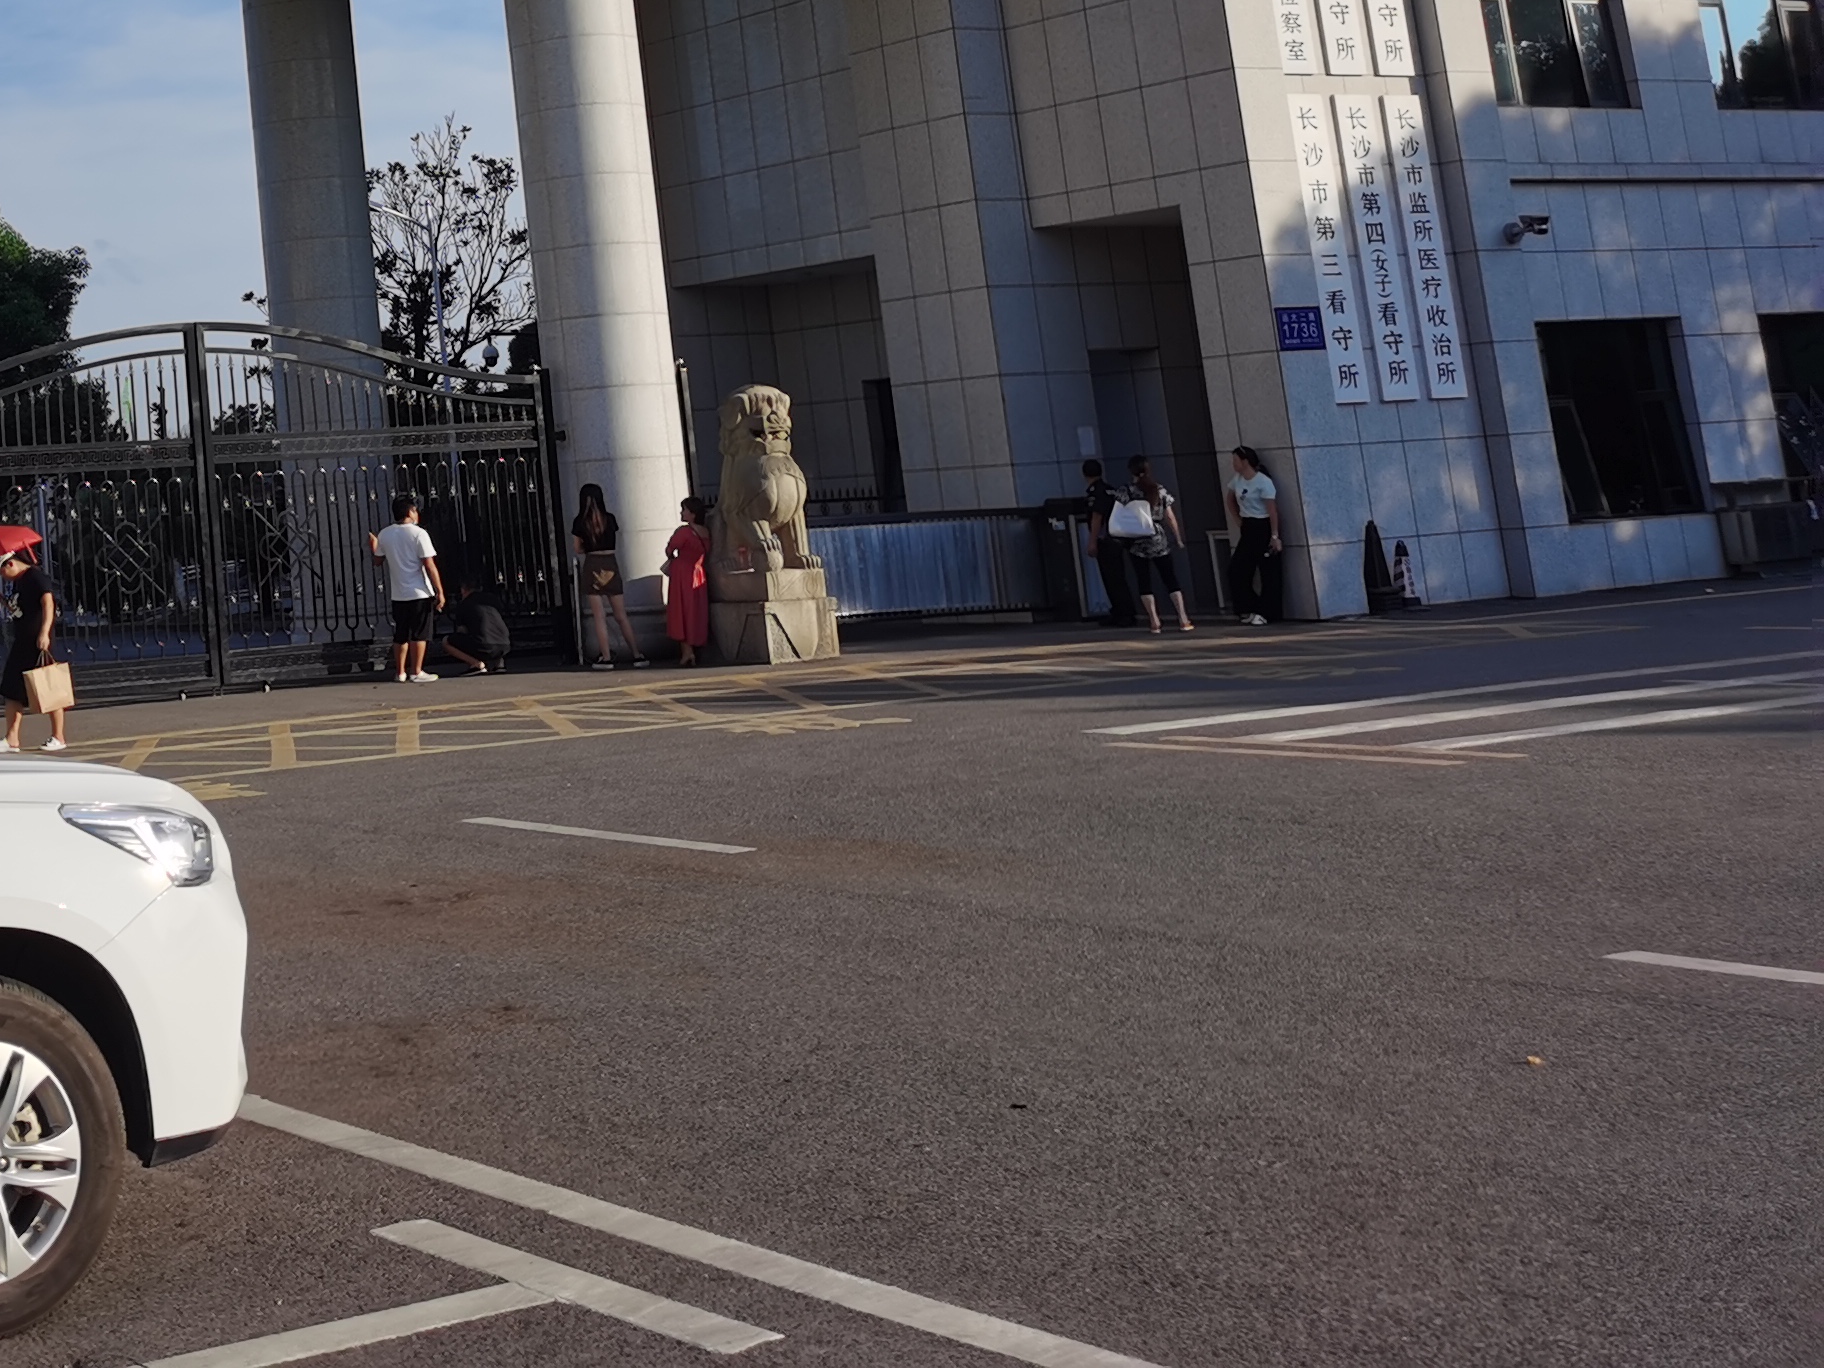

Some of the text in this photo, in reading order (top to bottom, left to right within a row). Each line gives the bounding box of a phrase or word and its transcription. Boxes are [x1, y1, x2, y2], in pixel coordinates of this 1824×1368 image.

[1282, 322, 1319, 338] 1736
[1296, 106, 1360, 390] 长沙市第三看守所
[1345, 106, 1410, 386] 长沙市第四（女子）看守所
[1393, 107, 1458, 386] 长沙市监所医疗收治所
